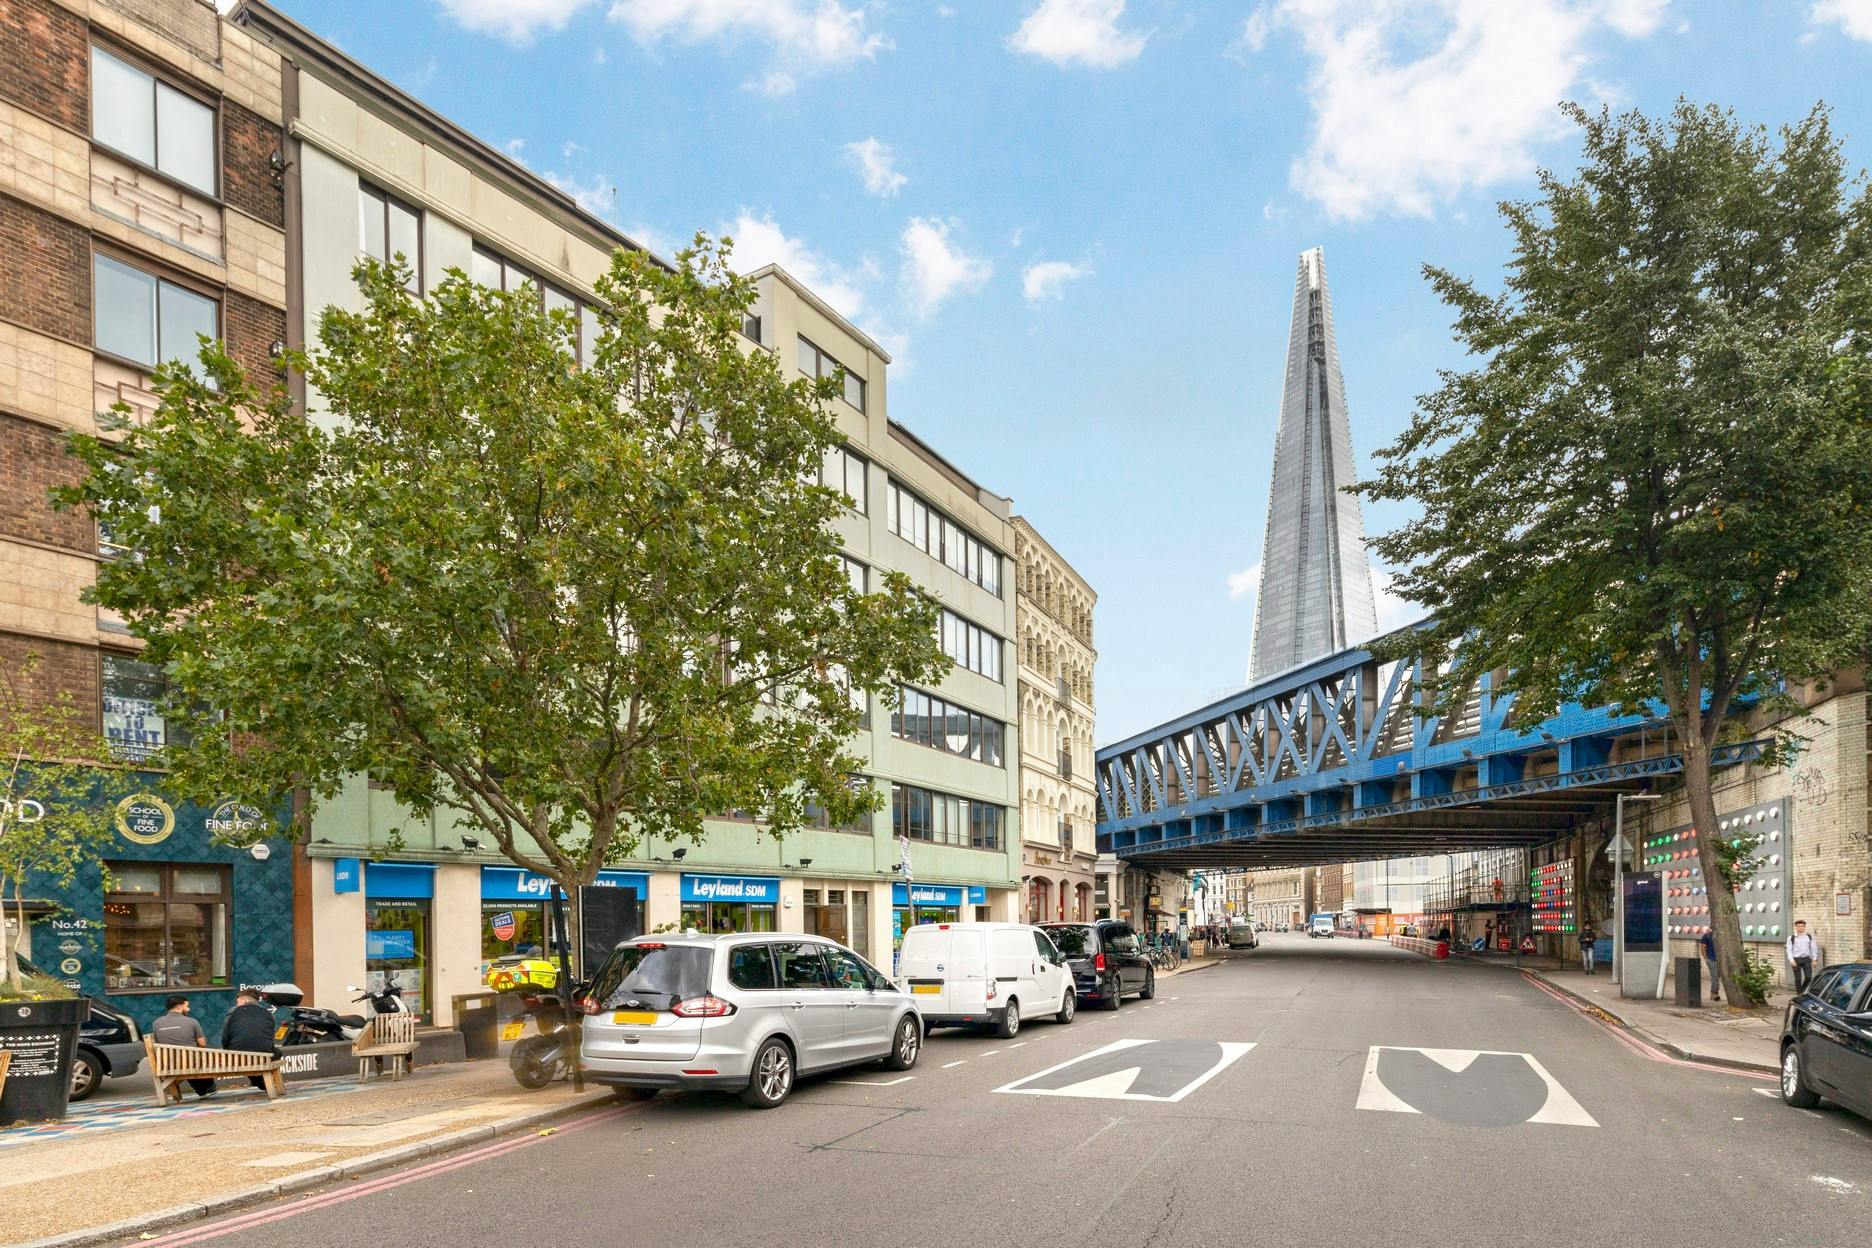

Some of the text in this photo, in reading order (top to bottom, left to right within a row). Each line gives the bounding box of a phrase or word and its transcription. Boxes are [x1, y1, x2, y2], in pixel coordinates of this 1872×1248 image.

[128, 807, 162, 815] SCHOOL
[137, 818, 155, 826] FINE
[205, 818, 232, 830] FINE
[52, 920, 87, 929] No.42
